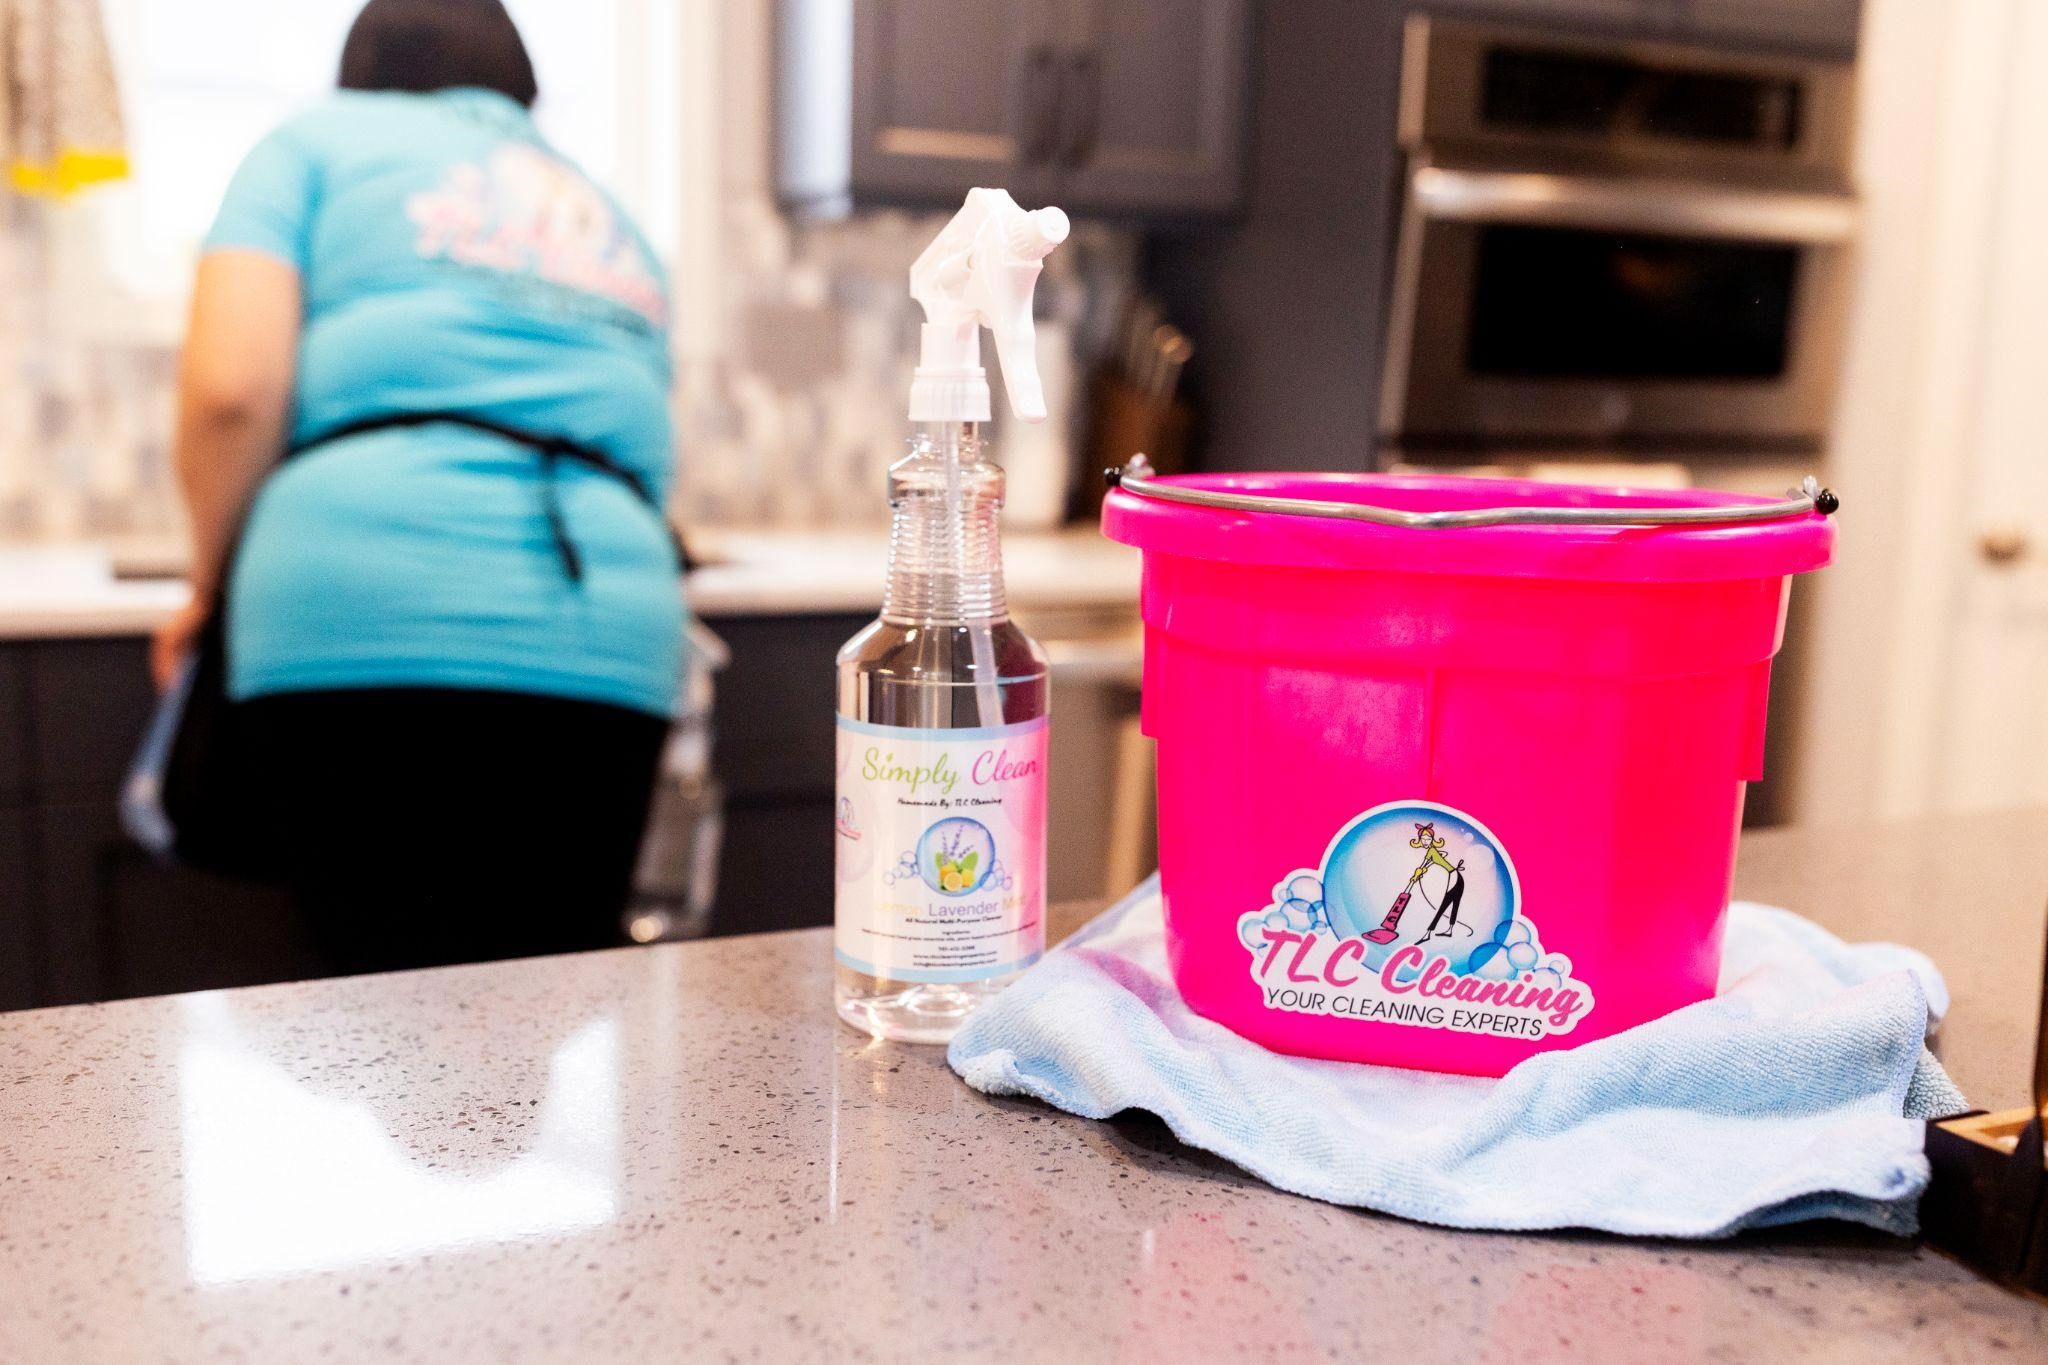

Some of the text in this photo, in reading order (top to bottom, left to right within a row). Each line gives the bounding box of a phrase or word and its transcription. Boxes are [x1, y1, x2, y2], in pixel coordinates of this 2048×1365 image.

[862, 746, 1038, 795] Simply Clean
[928, 900, 999, 917] Lavender
[1259, 927, 1585, 1027] TLC Cleaning
[1267, 987, 1543, 1037] YOUR CLEANING EXPERTS
